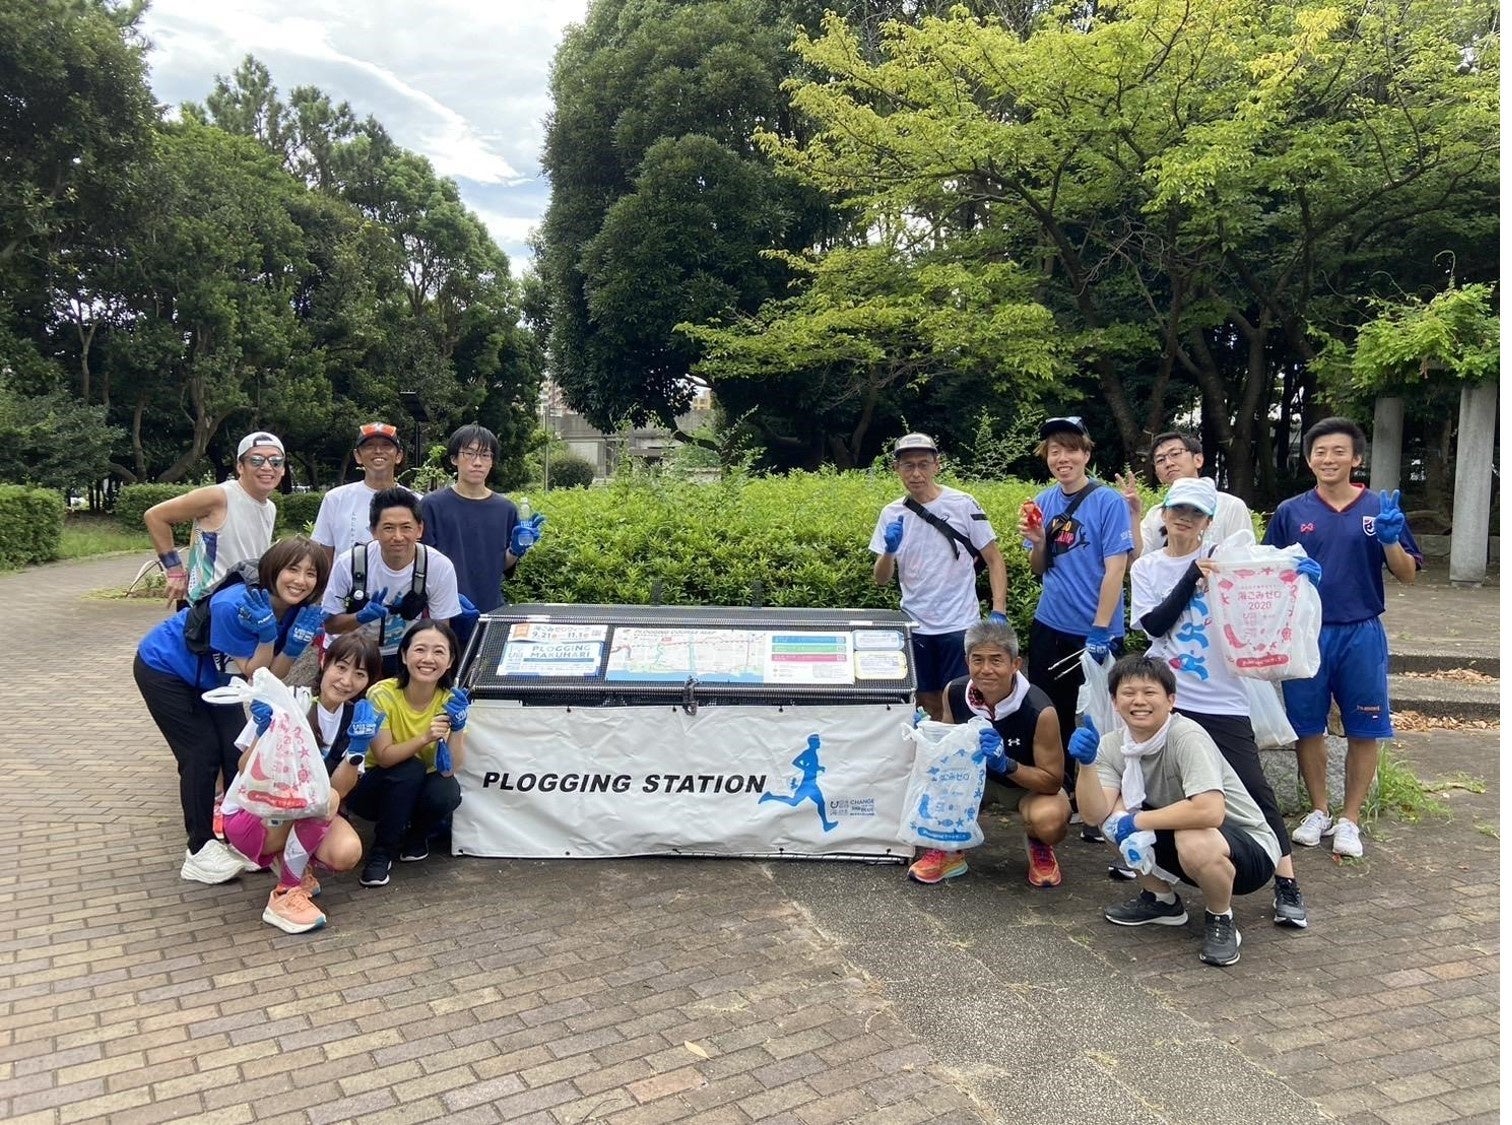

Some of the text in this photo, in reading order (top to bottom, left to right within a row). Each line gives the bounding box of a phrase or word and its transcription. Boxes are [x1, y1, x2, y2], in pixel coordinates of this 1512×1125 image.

[1248, 601, 1272, 610] 2020
[532, 644, 592, 653] PLOGGING
[529, 651, 590, 659] MAKUHARI
[482, 771, 767, 794] PLOGGING STATION
